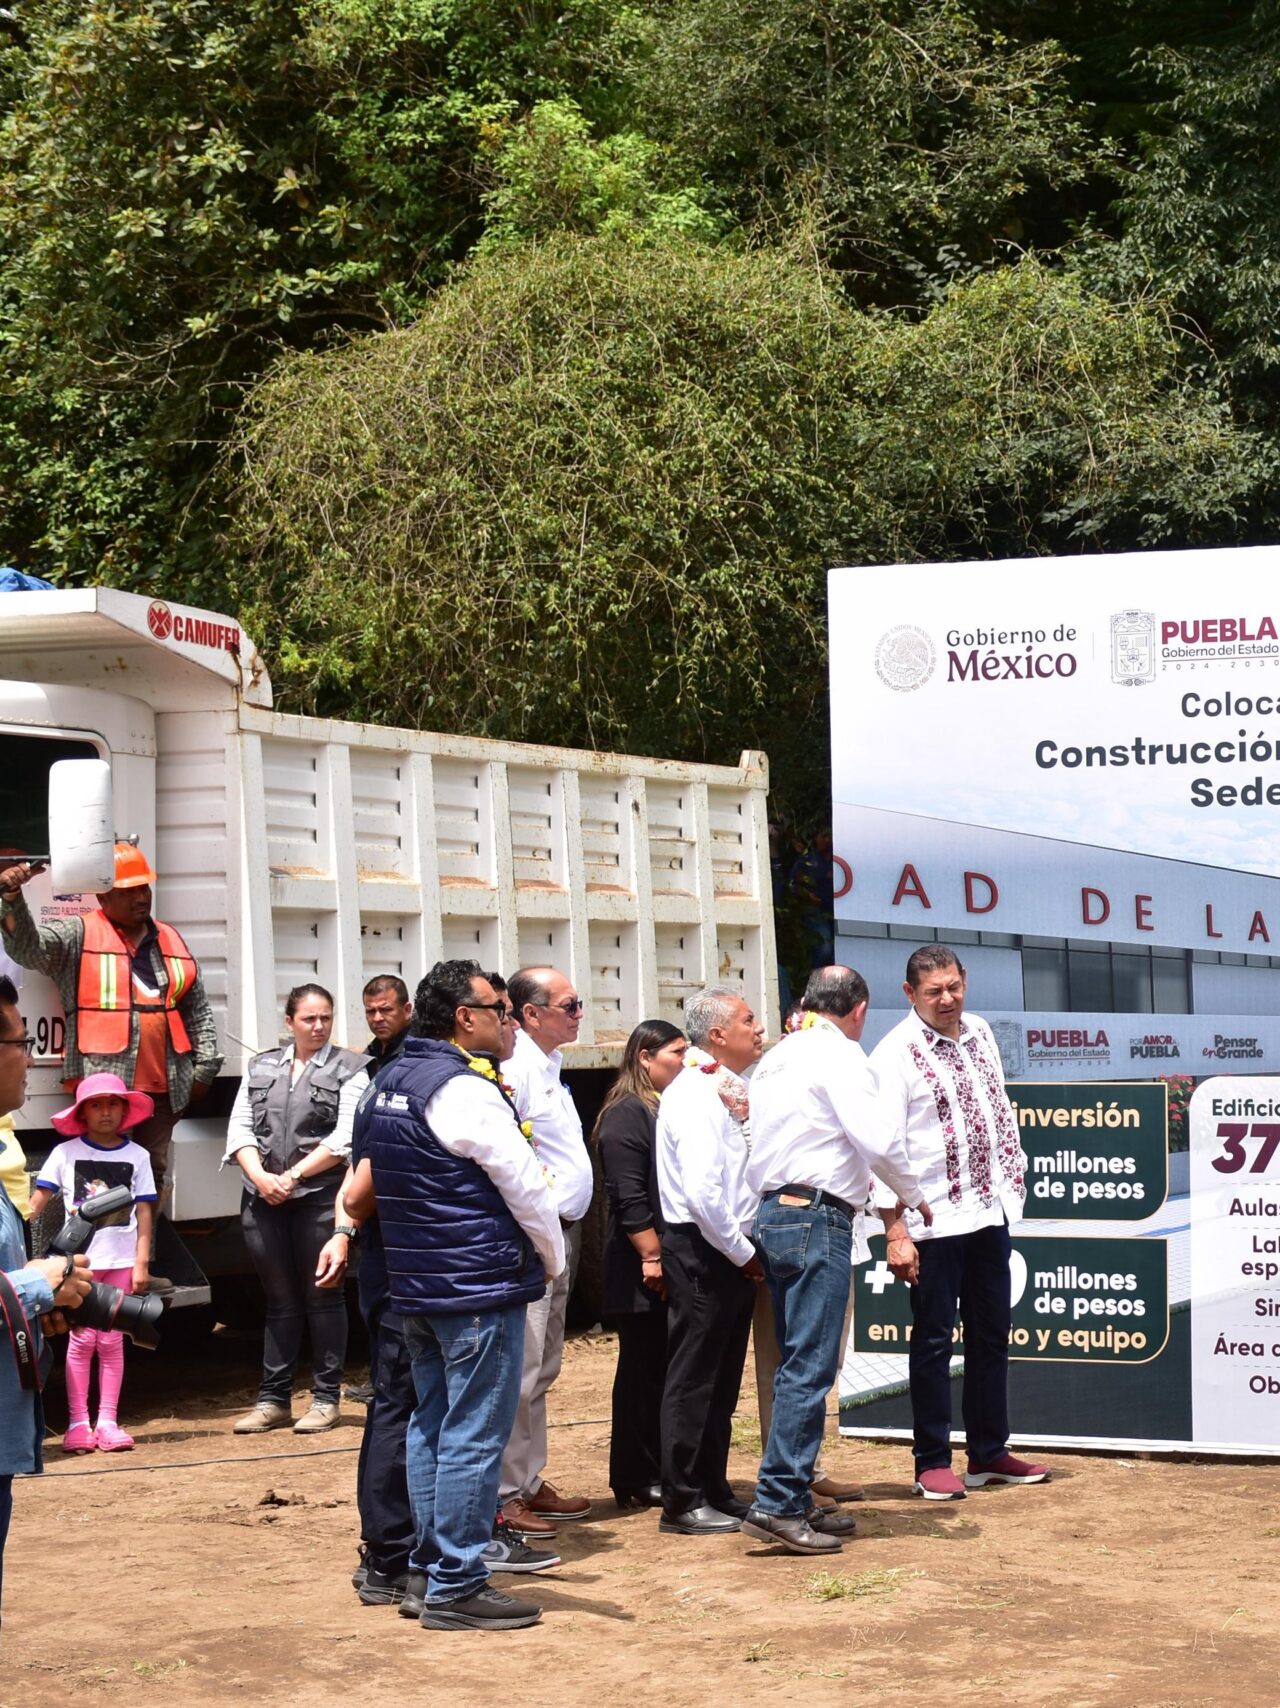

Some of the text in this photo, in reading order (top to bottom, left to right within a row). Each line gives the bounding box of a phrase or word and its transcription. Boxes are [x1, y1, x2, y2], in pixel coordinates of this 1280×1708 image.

[173, 615, 241, 651] CAMUFER
[947, 624, 1077, 647] Gobierno de
[1161, 617, 1279, 645] PUEBLA
[1162, 643, 1279, 658] Gobierno del Estado
[947, 645, 1077, 682] México
[1082, 887, 1154, 931] DE
[1206, 904, 1270, 943] LA
[1027, 1030, 1109, 1048] PUEBLA
[1215, 1034, 1258, 1048] Pensar
[1028, 1049, 1111, 1057] Gobierno del Estado
[1130, 1046, 1180, 1059] PUEBLA
[1217, 1047, 1263, 1059] Grande
[1013, 1102, 1140, 1128] inversión
[1034, 1150, 1136, 1174] millones
[1034, 1176, 1145, 1203] de pesos
[1034, 1266, 1137, 1291] millones
[1034, 1291, 1146, 1319] de pesos
[16, 1331, 29, 1363] Canon
[868, 1324, 898, 1341] en
[1036, 1329, 1051, 1351] y
[1057, 1325, 1147, 1354] equipo
[1214, 1332, 1264, 1356] Área
